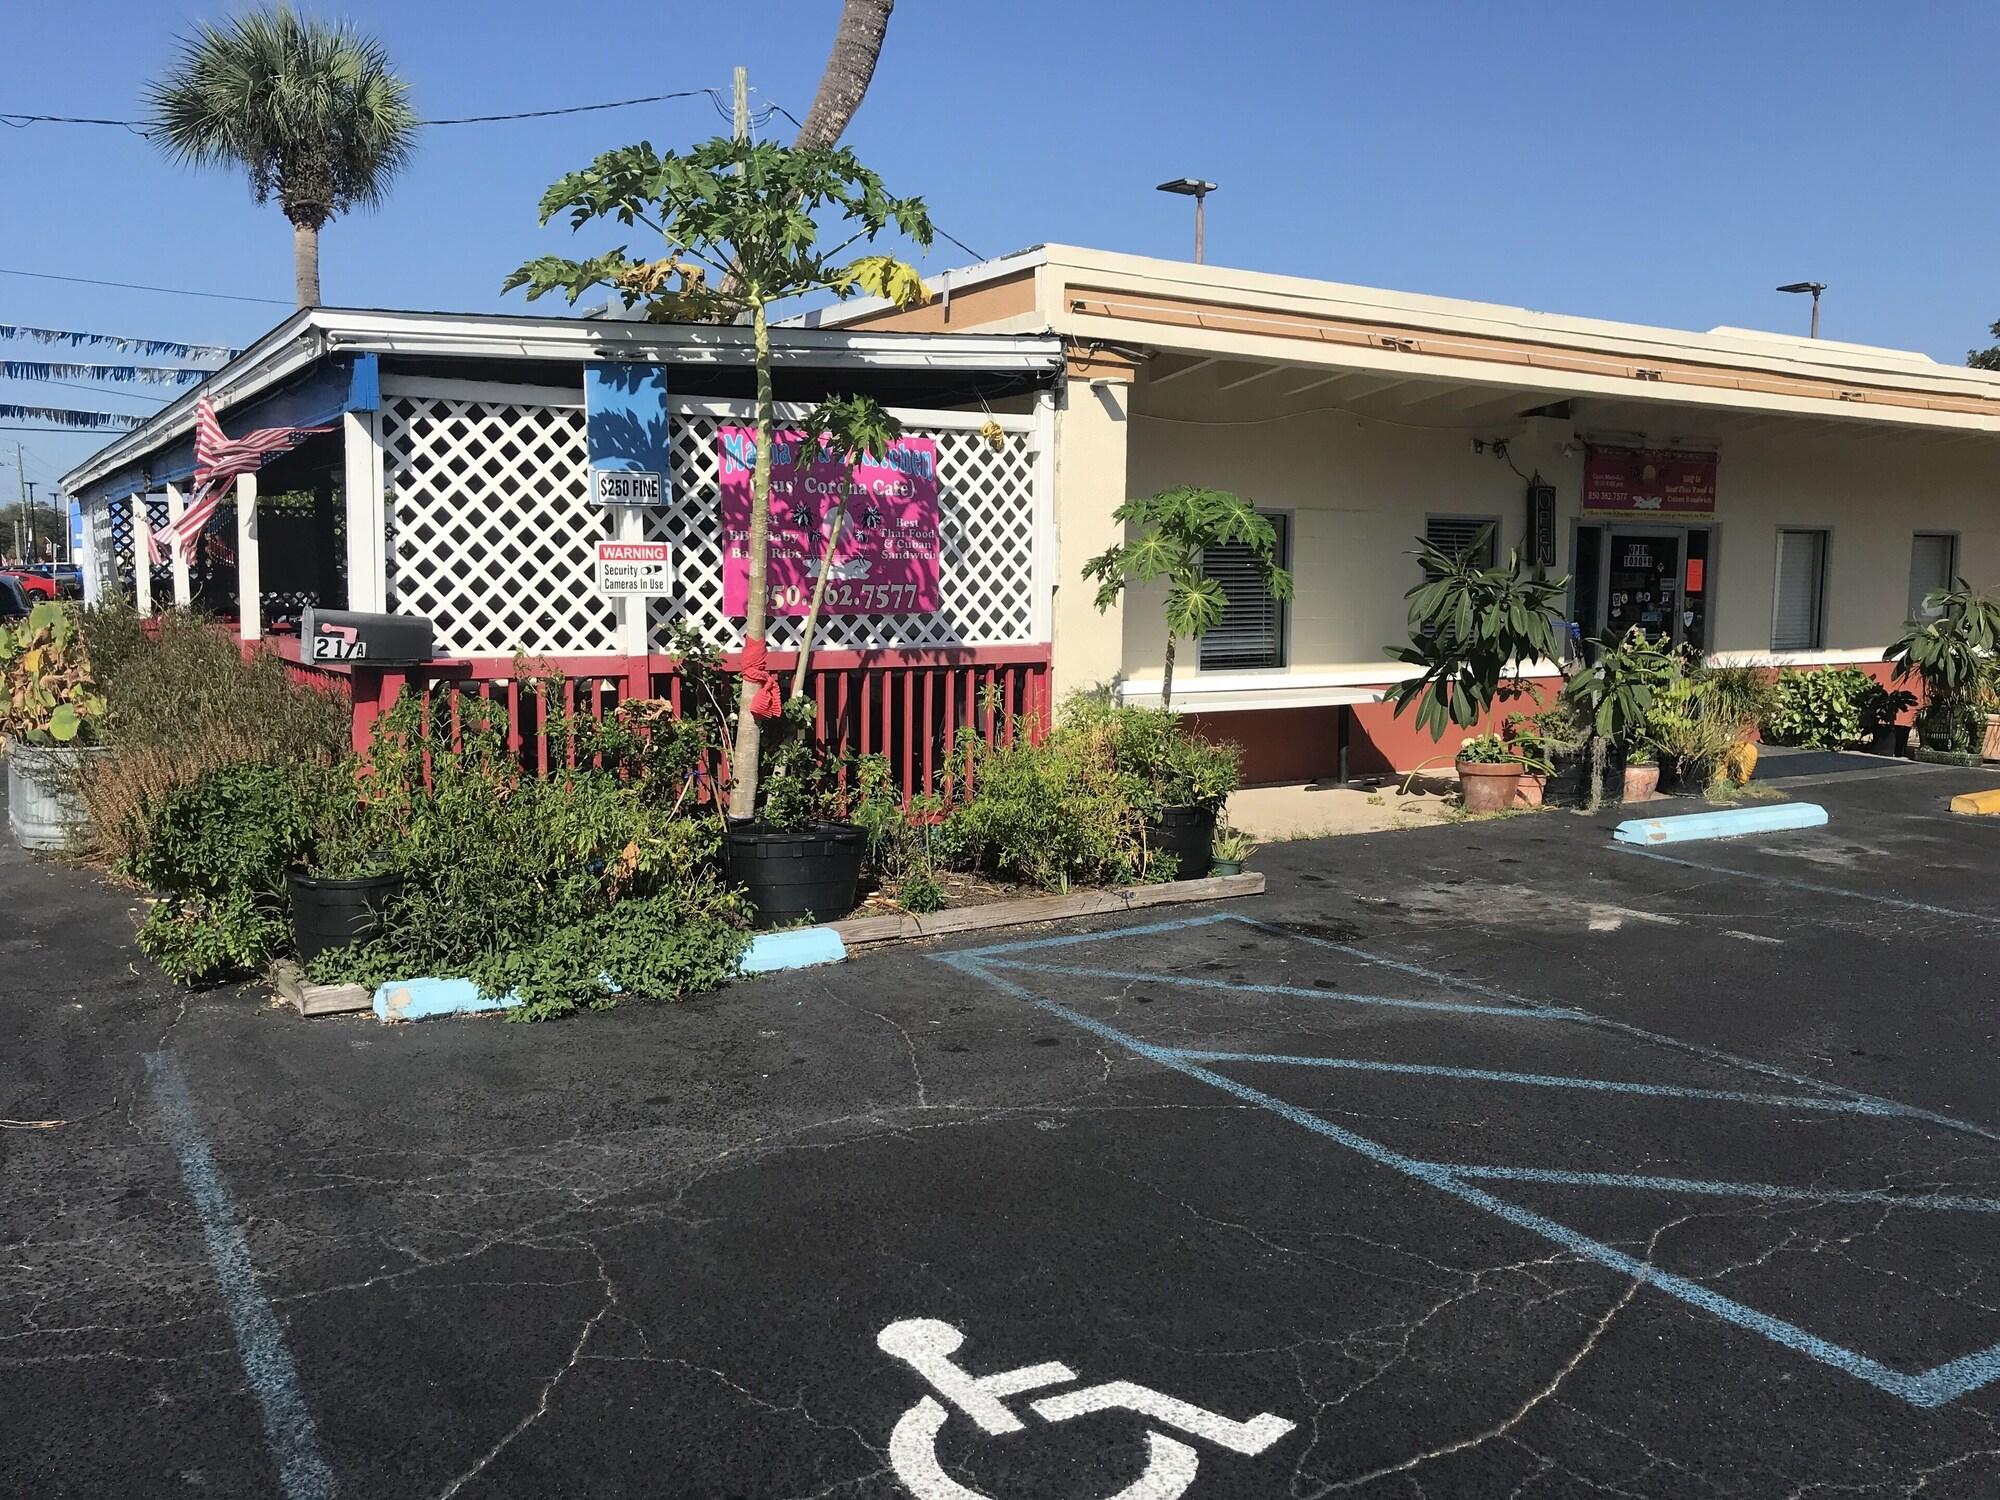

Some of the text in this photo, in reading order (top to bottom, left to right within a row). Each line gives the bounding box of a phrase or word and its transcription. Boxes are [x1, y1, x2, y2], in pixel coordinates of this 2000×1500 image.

[600, 479, 658, 498] $250 FINE
[873, 479, 916, 499] Cafe)
[896, 518, 919, 528] Best
[1539, 493, 1552, 563] OPEN
[730, 530, 757, 541] BB
[880, 528, 935, 538] Thai Food
[883, 539, 931, 549] & Cuban
[603, 547, 665, 560] WARNING
[772, 548, 802, 559] Ribs
[881, 550, 936, 560] Sandwich
[604, 564, 638, 577] Security
[604, 578, 664, 590] Cameras In Use
[763, 583, 917, 610] 50.62.7577
